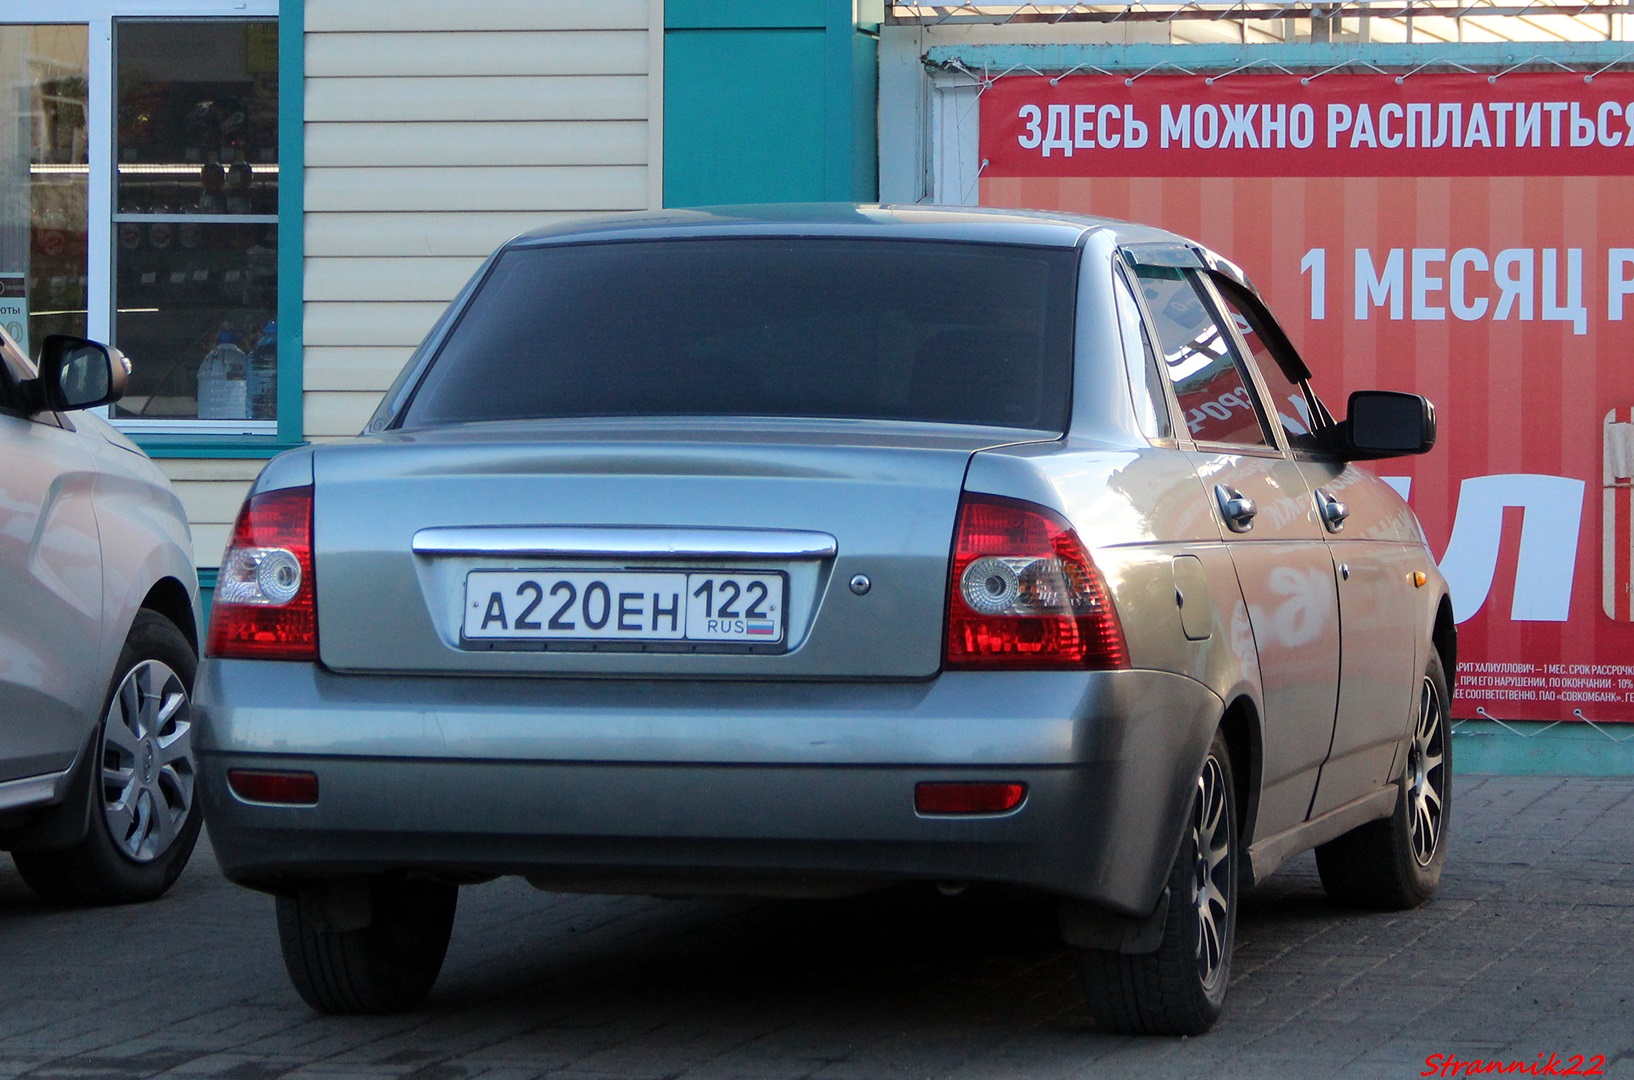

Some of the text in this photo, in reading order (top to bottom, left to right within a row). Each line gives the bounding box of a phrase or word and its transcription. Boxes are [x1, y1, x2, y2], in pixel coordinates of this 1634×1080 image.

[1018, 104, 1149, 157] ЗДЕСЬ
[1160, 103, 1314, 149] МОЖНО
[1300, 248, 1326, 320] 1
[1354, 247, 1588, 335] МЕСЯЦ
[692, 579, 769, 619] 122
[707, 619, 745, 634] RUS
[1475, 662, 1535, 673] ХАЛИУЛЛОВИЧ
[1549, 664, 1568, 674] МЕС.
[1569, 664, 1591, 675] СРОК
[1591, 665, 1634, 676] РАССРОЧК
[1460, 675, 1477, 686] ПРИ
[1479, 676, 1493, 686] ЕГО
[1494, 676, 1548, 688] НАРУШЕНИИ,
[1549, 677, 1560, 688] ПО
[1561, 677, 1611, 689] ОКОНЧАНИИ
[1618, 679, 1634, 689] 10%
[1453, 689, 1464, 699] ЕЕ
[1539, 690, 1556, 701] ПАО
